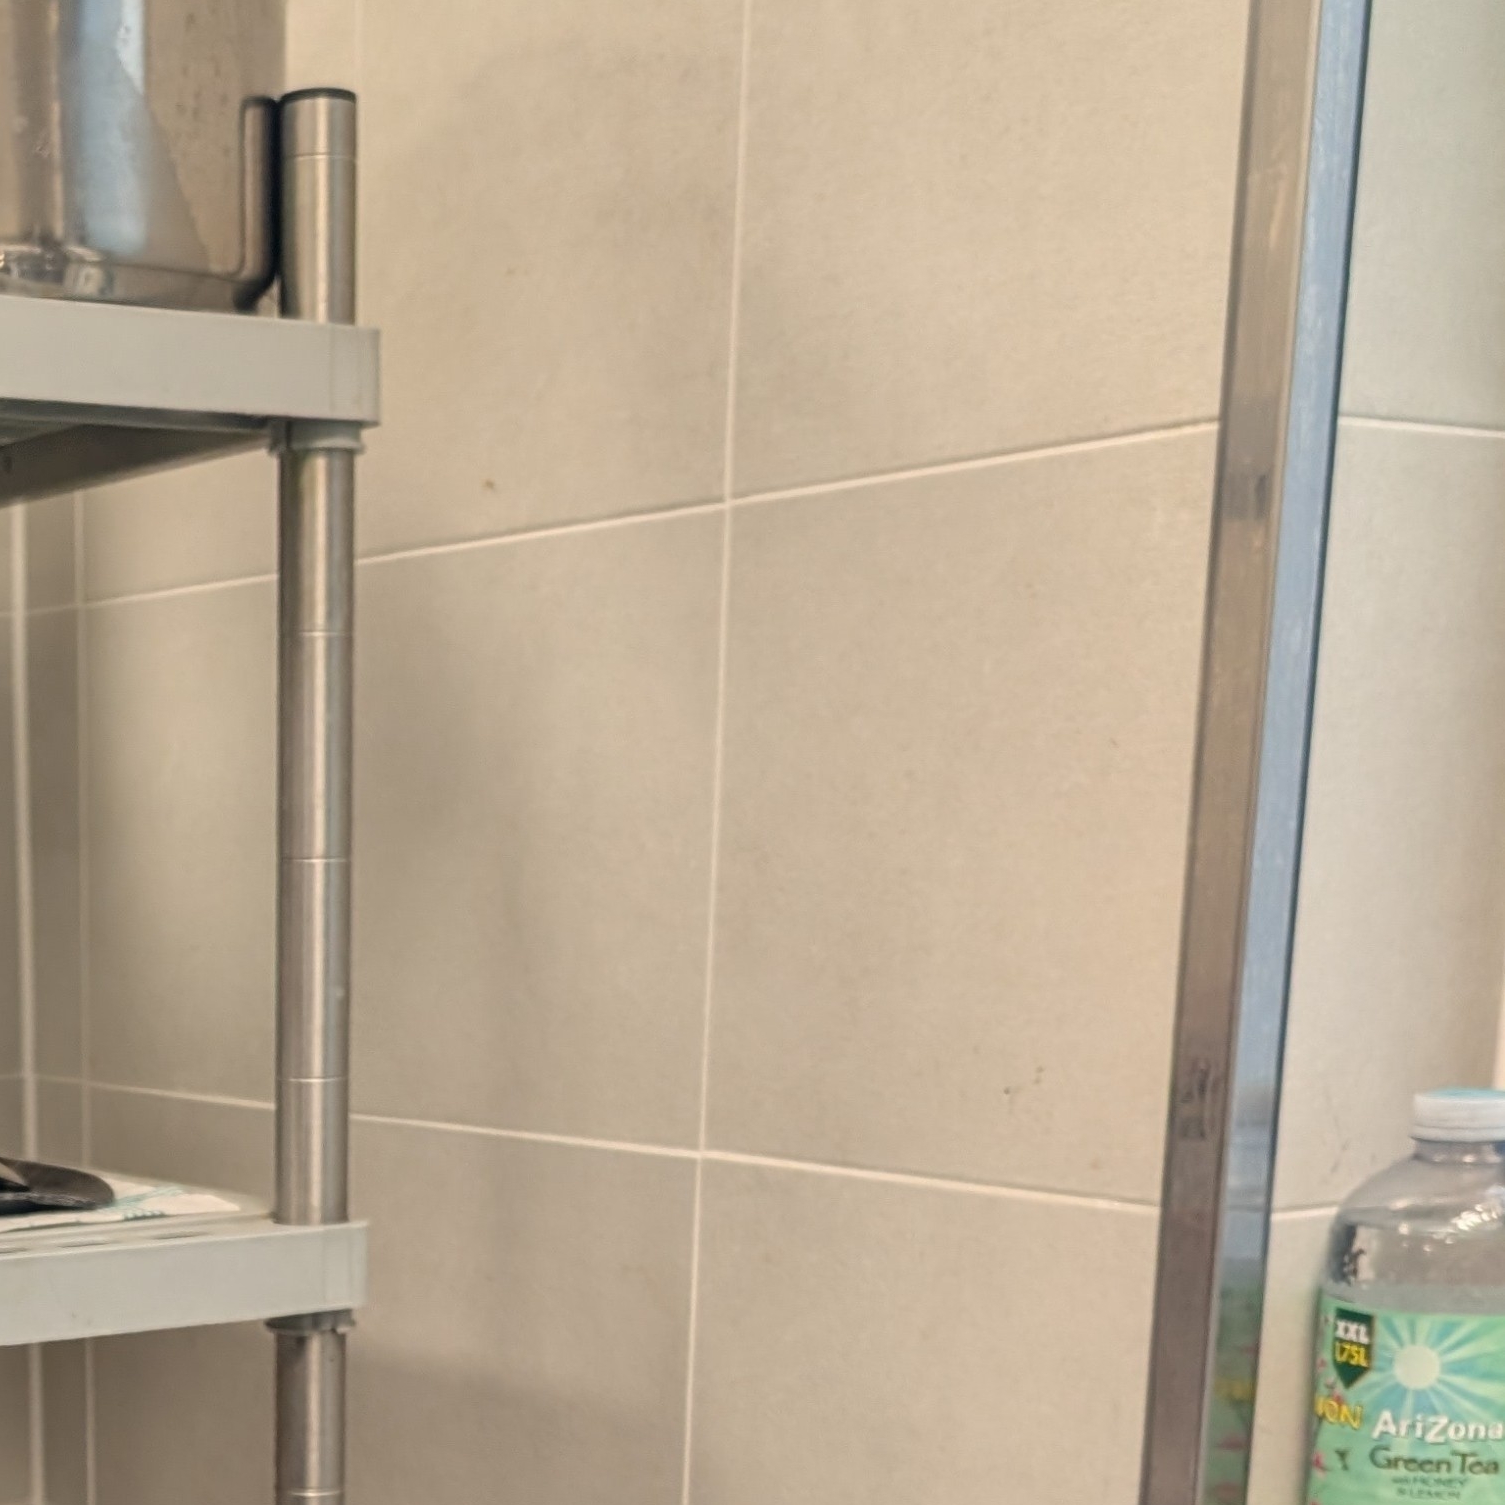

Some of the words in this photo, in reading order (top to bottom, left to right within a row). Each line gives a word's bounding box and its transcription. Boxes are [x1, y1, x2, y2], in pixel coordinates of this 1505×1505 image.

[1335, 1320, 1370, 1345] XXL
[1371, 1409, 1504, 1444] AriZona
[1369, 1445, 1451, 1474] Green
[1450, 1451, 1499, 1475] Tea
